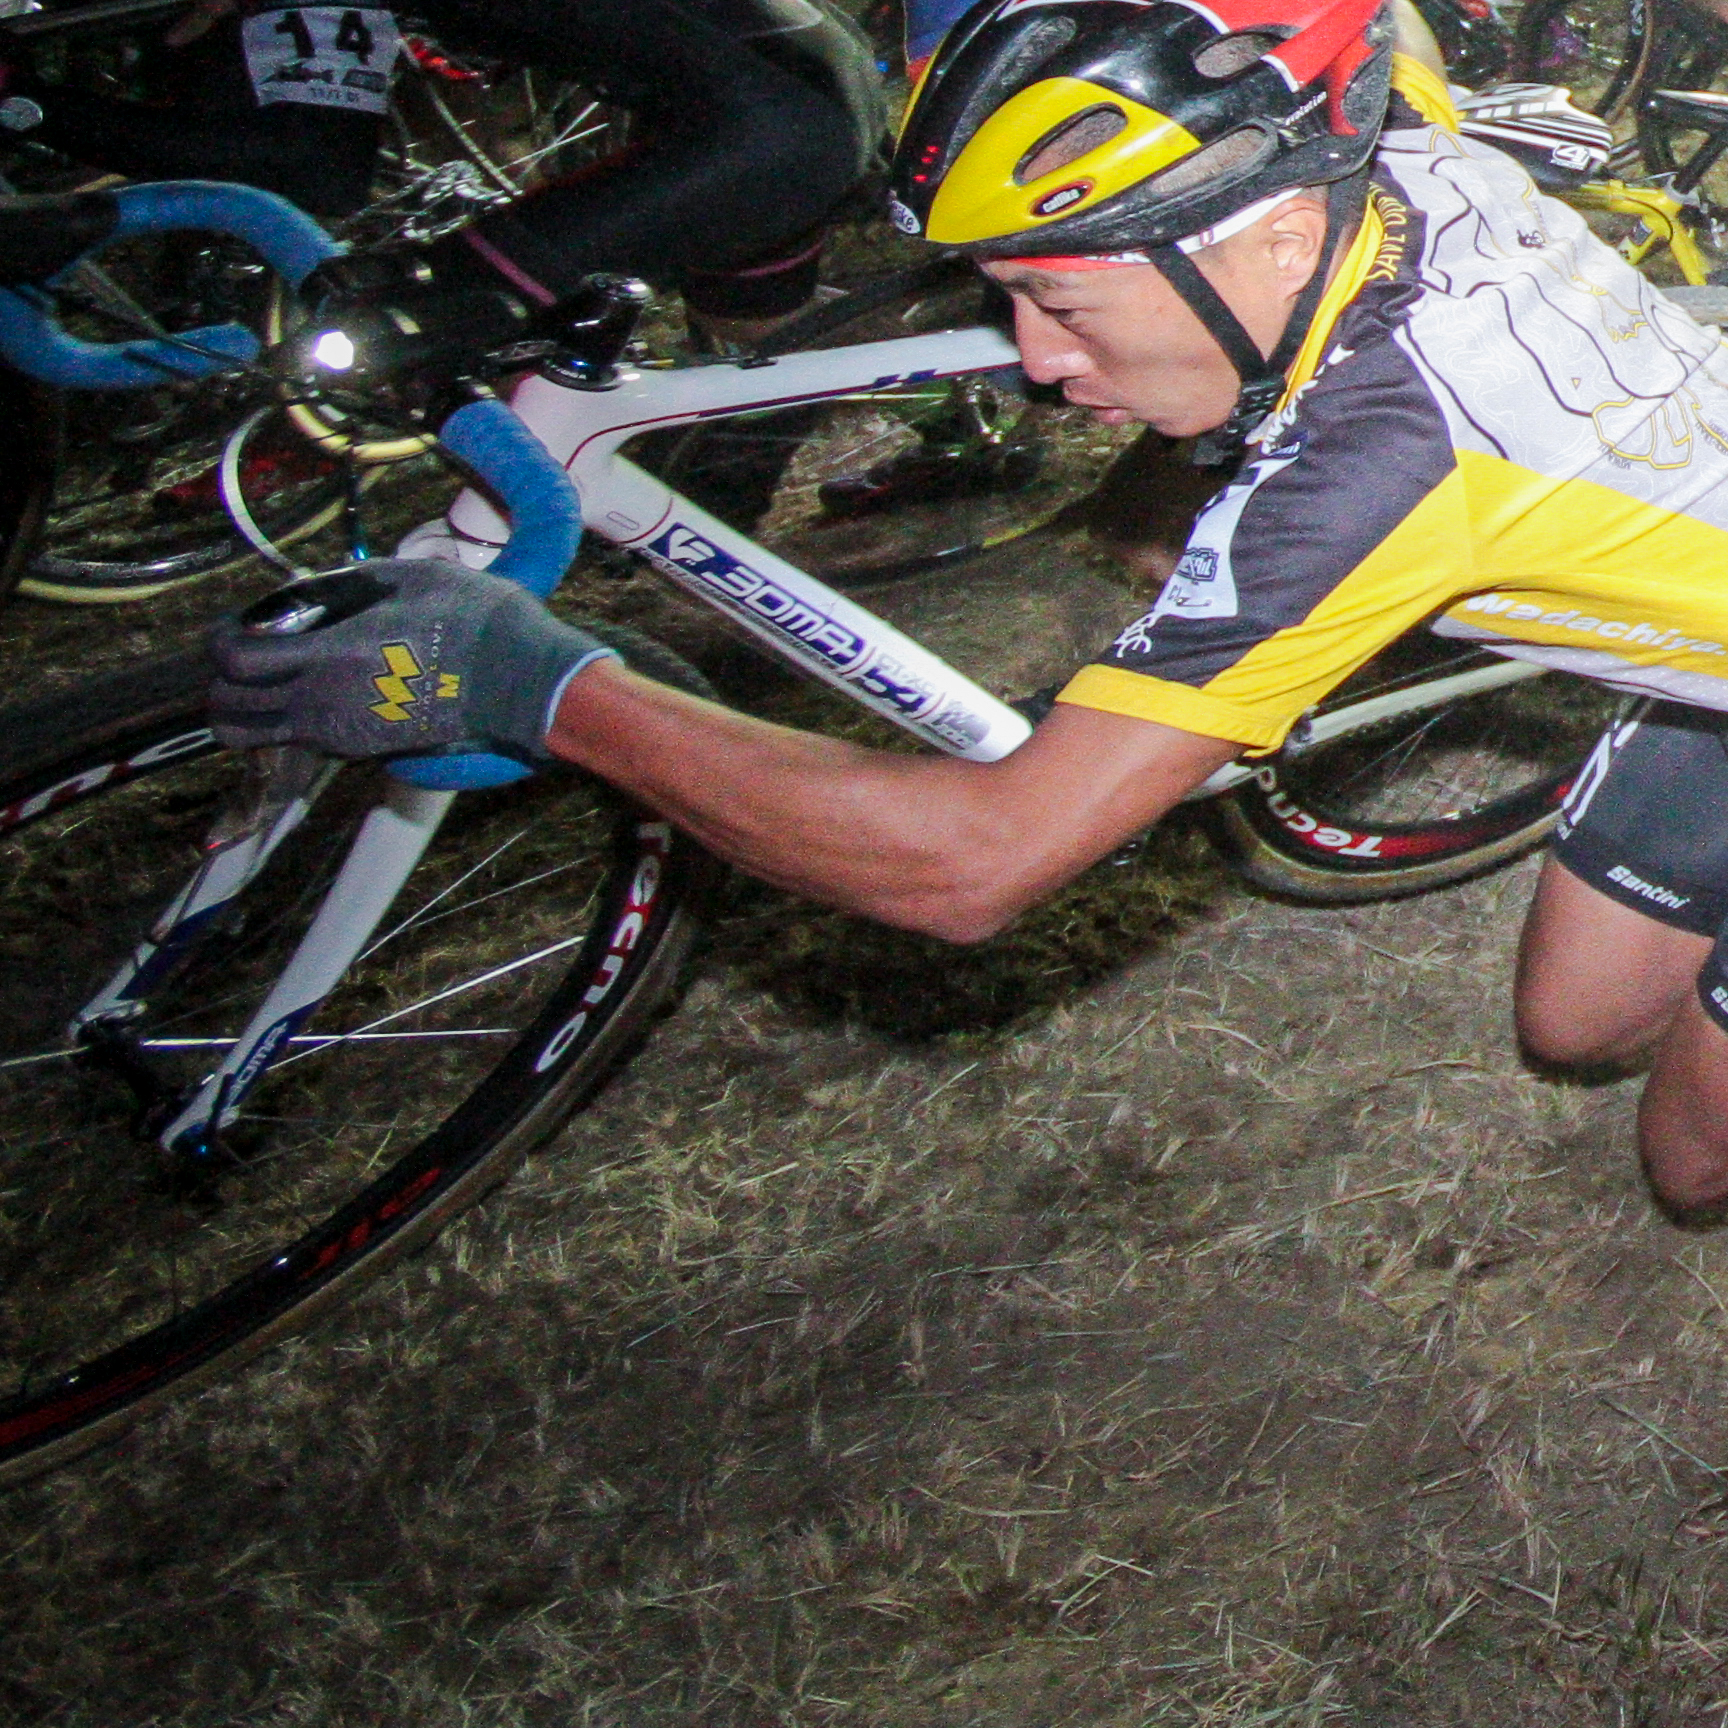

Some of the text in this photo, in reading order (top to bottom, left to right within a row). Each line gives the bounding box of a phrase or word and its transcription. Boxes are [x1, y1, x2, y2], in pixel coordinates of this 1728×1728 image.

[274, 9, 376, 66] 14
[1256, 764, 1384, 859] Tecno
[1606, 864, 1692, 911] Santini
